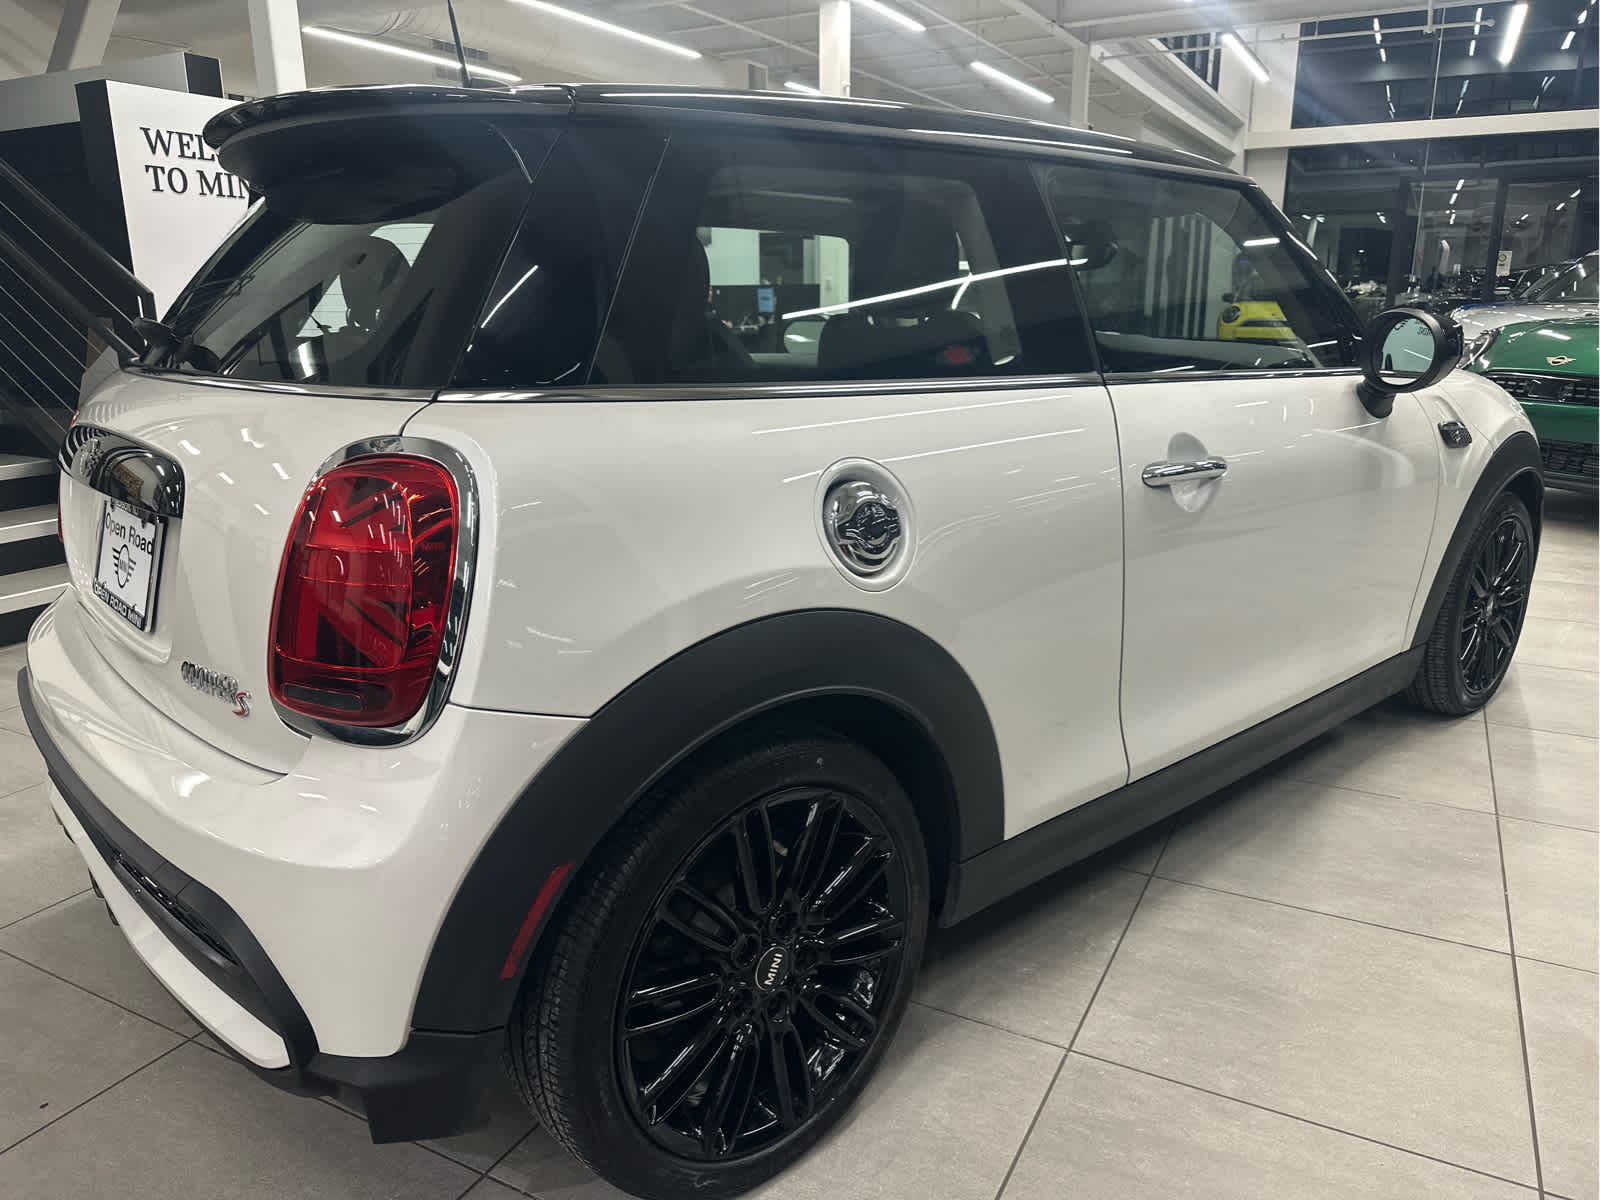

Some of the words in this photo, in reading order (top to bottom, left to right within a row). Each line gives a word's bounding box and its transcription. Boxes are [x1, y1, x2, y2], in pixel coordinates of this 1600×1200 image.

[139, 127, 219, 162] WEL
[145, 164, 188, 194] TO
[106, 512, 126, 539] Open
[129, 525, 153, 555] Road
[109, 597, 127, 617] ROAD
[231, 691, 251, 717] S
[763, 953, 784, 985] MINI
